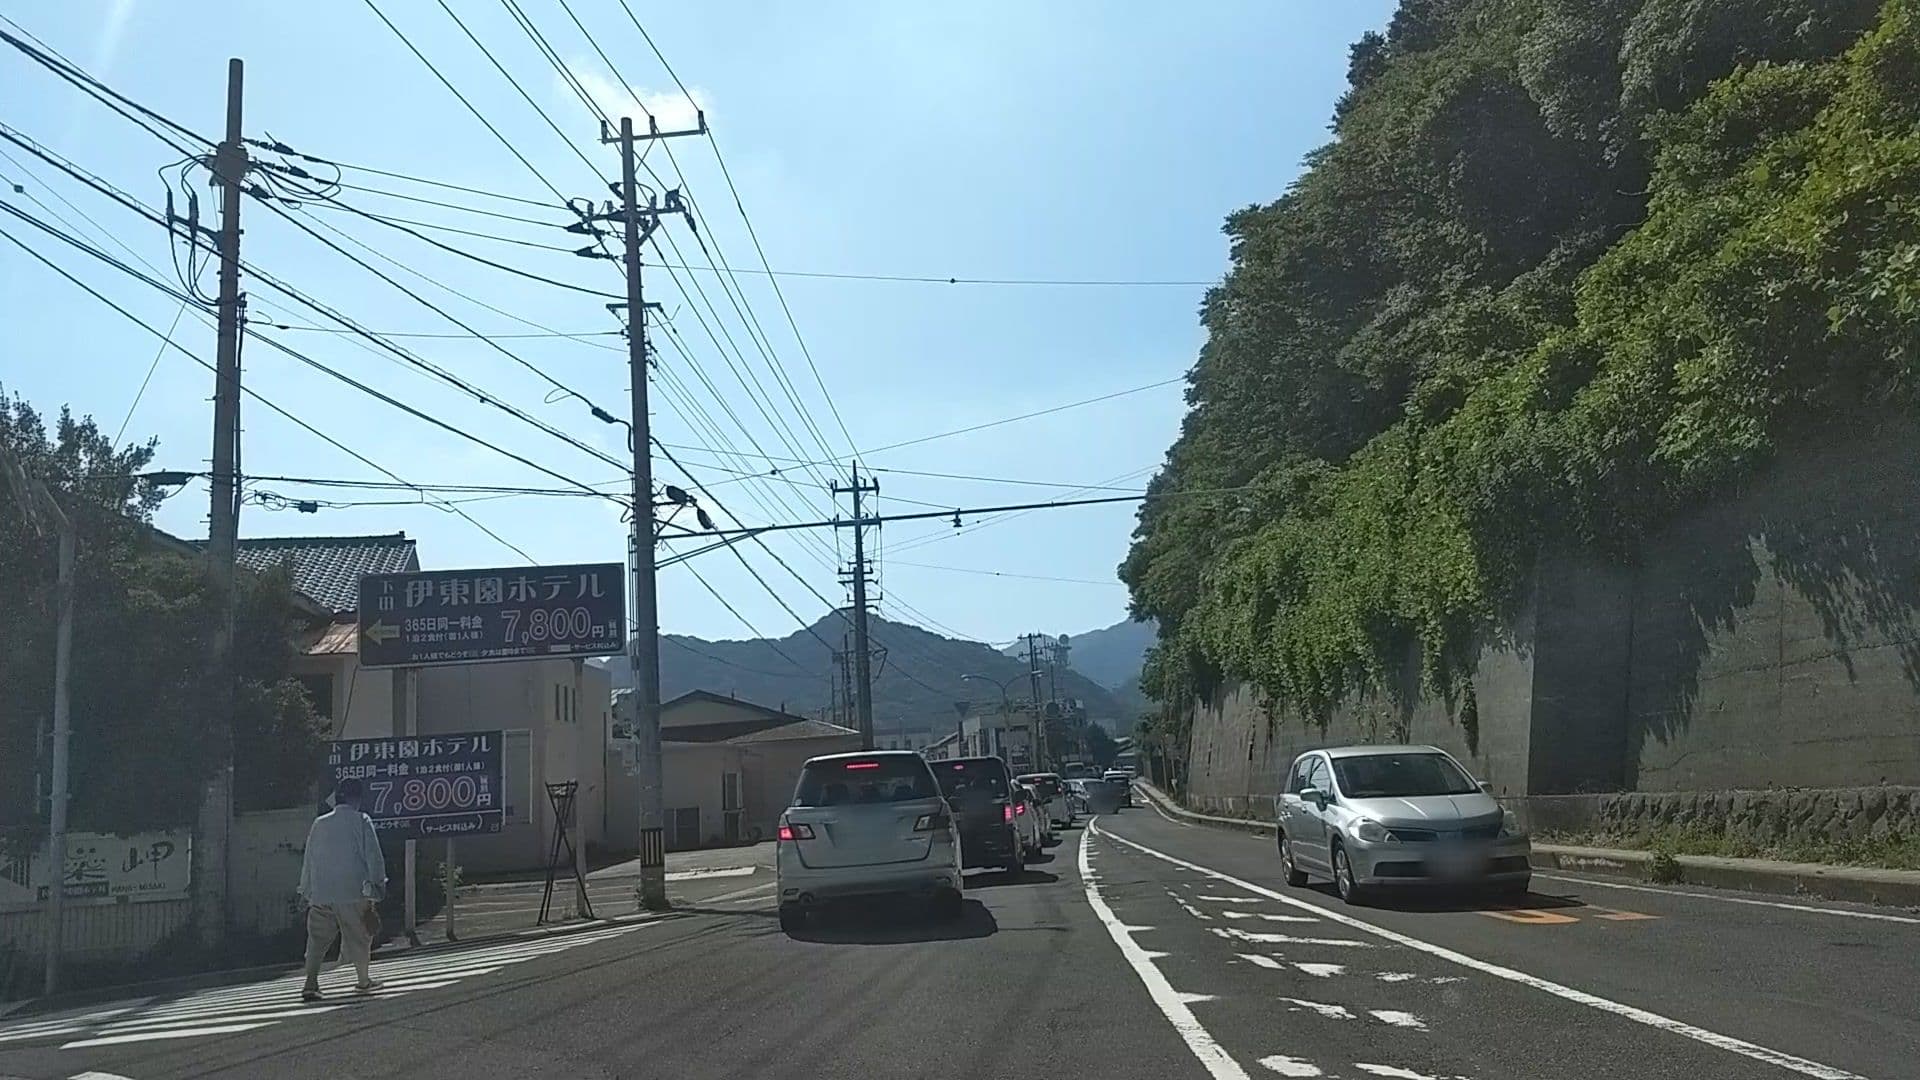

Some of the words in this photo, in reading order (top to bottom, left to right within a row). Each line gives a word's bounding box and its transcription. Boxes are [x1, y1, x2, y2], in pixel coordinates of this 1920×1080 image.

[405, 573, 607, 607] 伊東園ホテル
[405, 615, 483, 632] 365日同一料金
[501, 606, 604, 645] 7,800円
[350, 736, 492, 761] 伊東園ホテル
[335, 763, 409, 779] 365日同一料金
